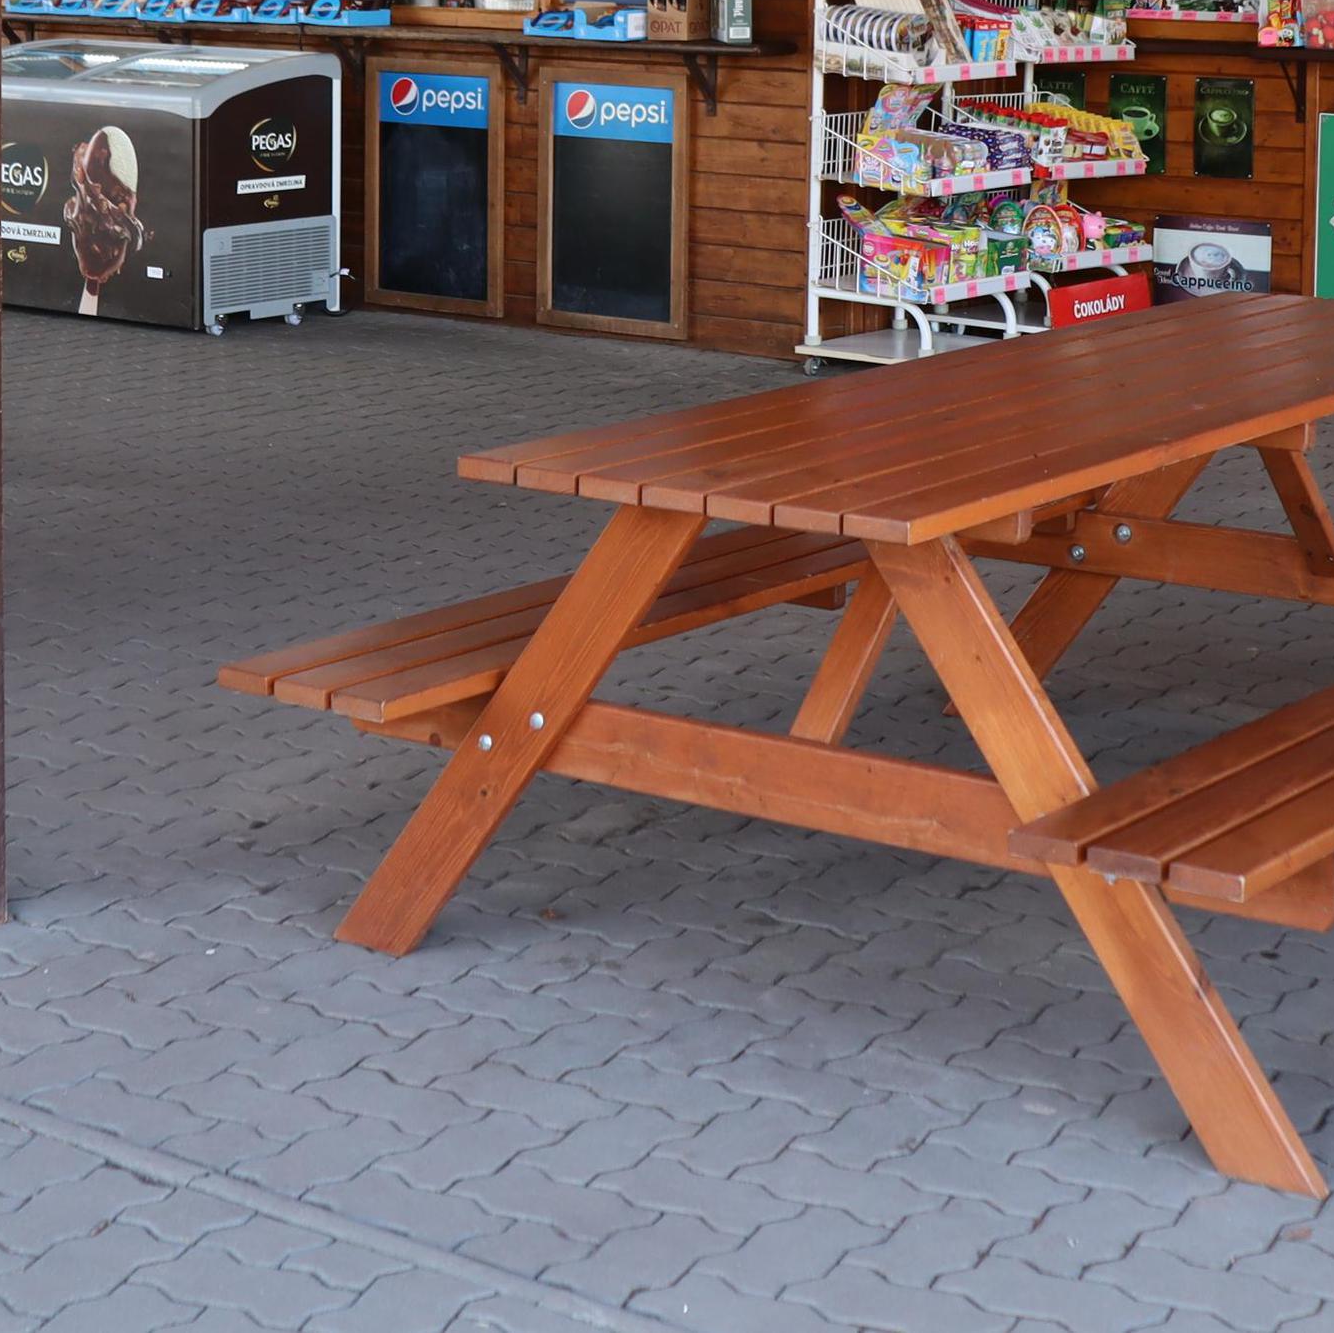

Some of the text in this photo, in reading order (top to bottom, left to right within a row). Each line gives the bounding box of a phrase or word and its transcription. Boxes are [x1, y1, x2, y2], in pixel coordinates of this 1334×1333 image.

[422, 87, 483, 114] pepsi
[600, 99, 666, 128] pepsi
[251, 132, 293, 151] PEGAS
[1, 162, 43, 188] EGAS
[21, 227, 58, 241] ZMRZLINA
[1171, 272, 1253, 293] Cappuccino
[1072, 292, 1126, 319] ČOKOLÁDY
